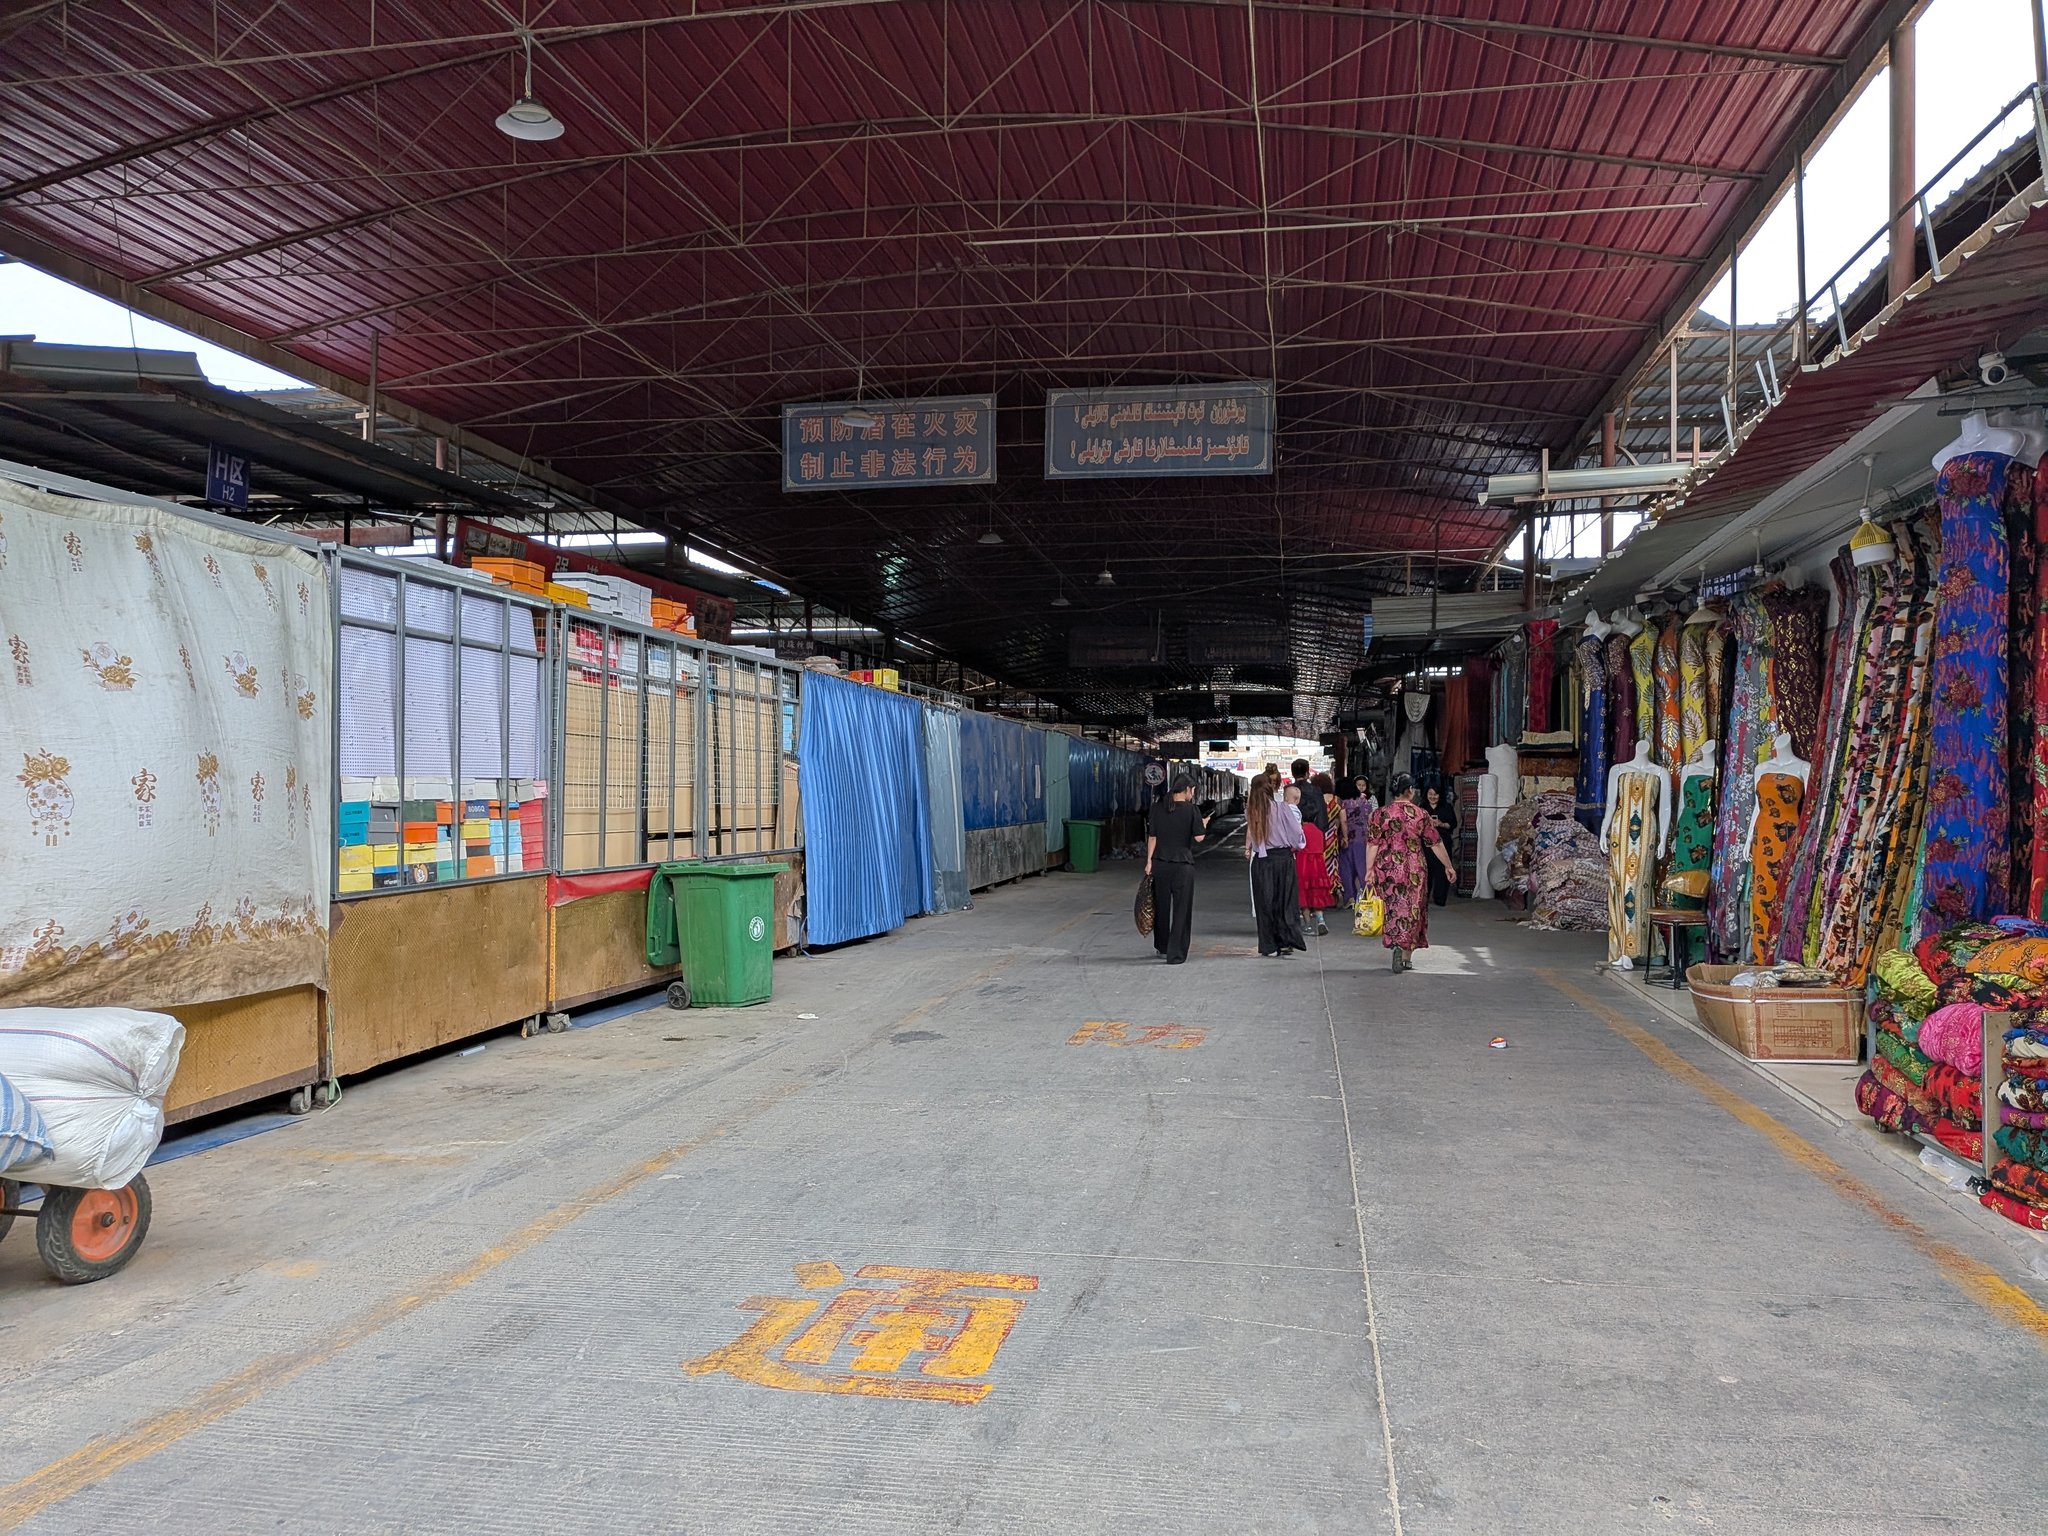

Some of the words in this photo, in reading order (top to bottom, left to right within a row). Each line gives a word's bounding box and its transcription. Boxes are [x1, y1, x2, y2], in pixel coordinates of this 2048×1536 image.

[800, 408, 978, 443] 预防潜在火灾
[800, 446, 978, 481] 制止非法行为
[1113, 437, 1144, 463] قارشى
[215, 450, 245, 487] H区
[222, 484, 236, 502] H2
[131, 767, 158, 803] 家
[680, 1260, 1039, 1405] 通
